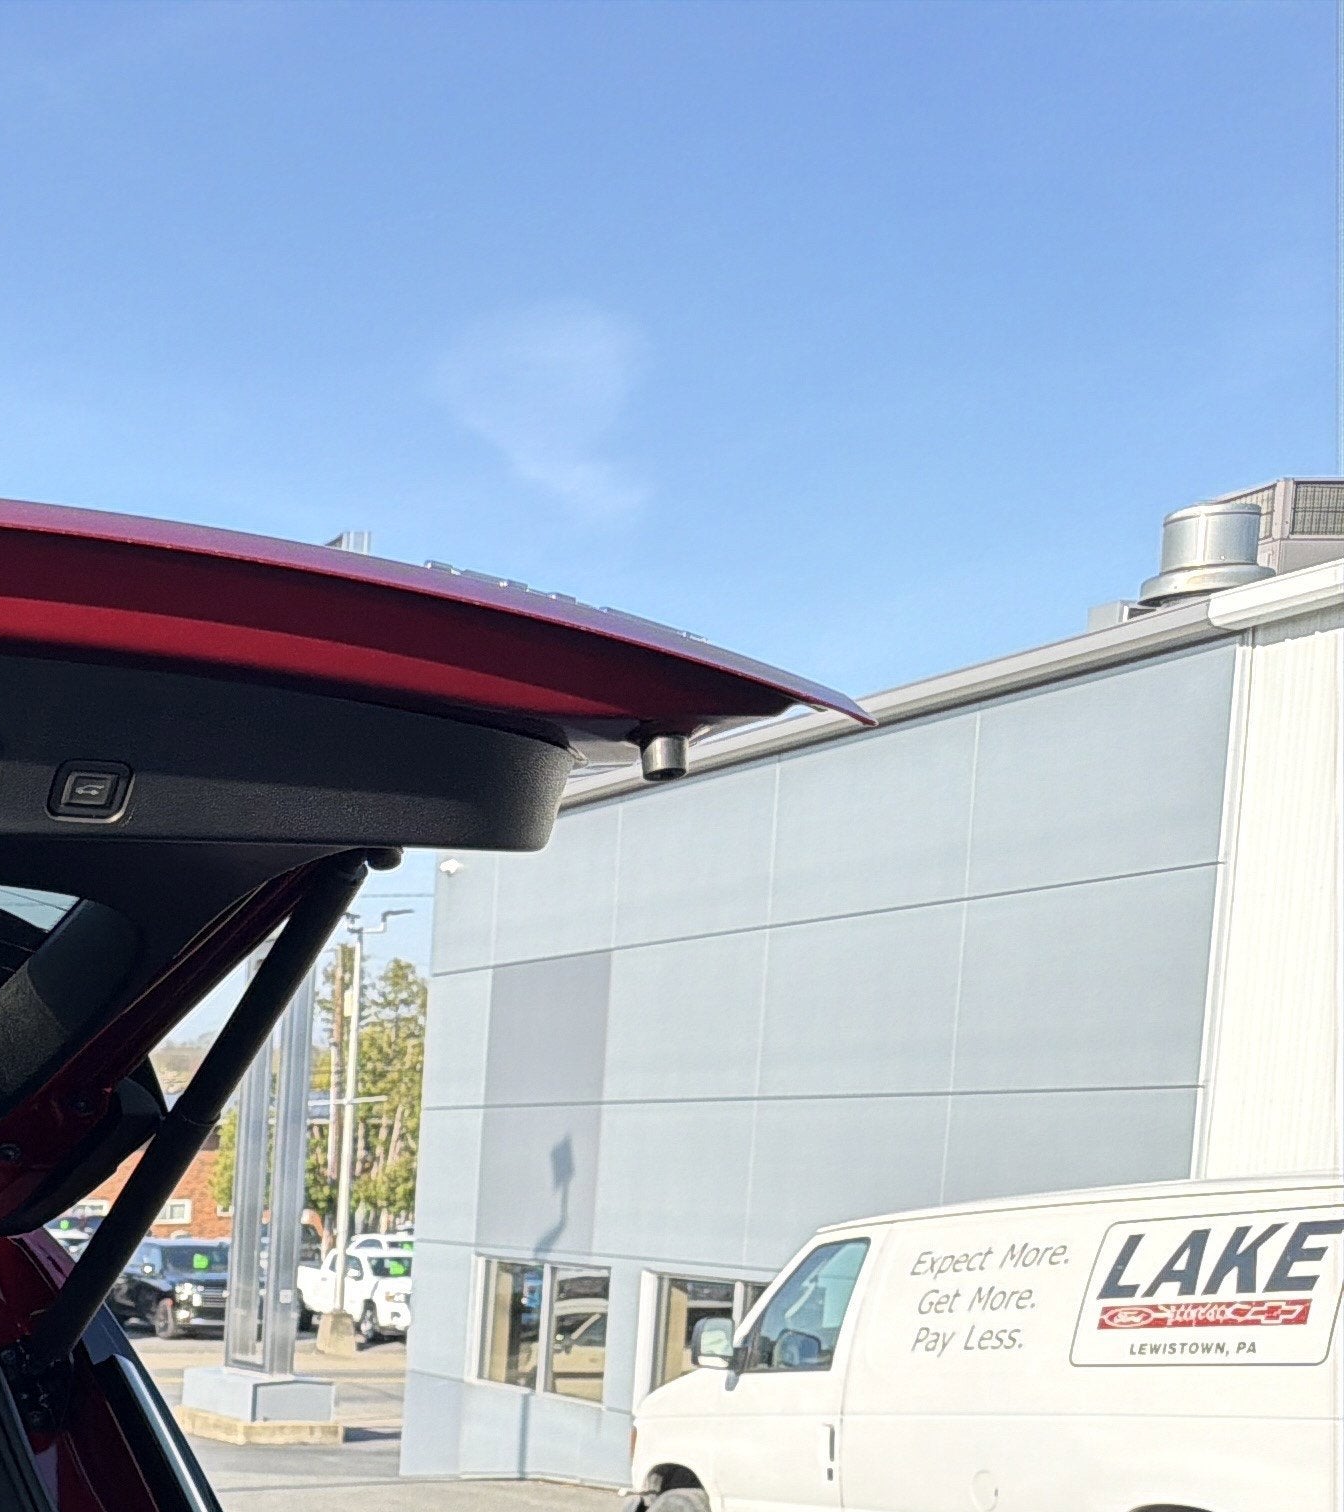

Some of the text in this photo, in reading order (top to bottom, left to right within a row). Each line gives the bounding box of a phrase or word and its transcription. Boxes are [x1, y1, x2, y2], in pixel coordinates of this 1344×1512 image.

[910, 1242, 1069, 1280] Expect More.
[1096, 1219, 1344, 1300] LAKE
[918, 1286, 1035, 1315] Get More.
[911, 1325, 1023, 1358] Pay Less.
[1129, 1341, 1257, 1357] LEWISTOWN, PA
